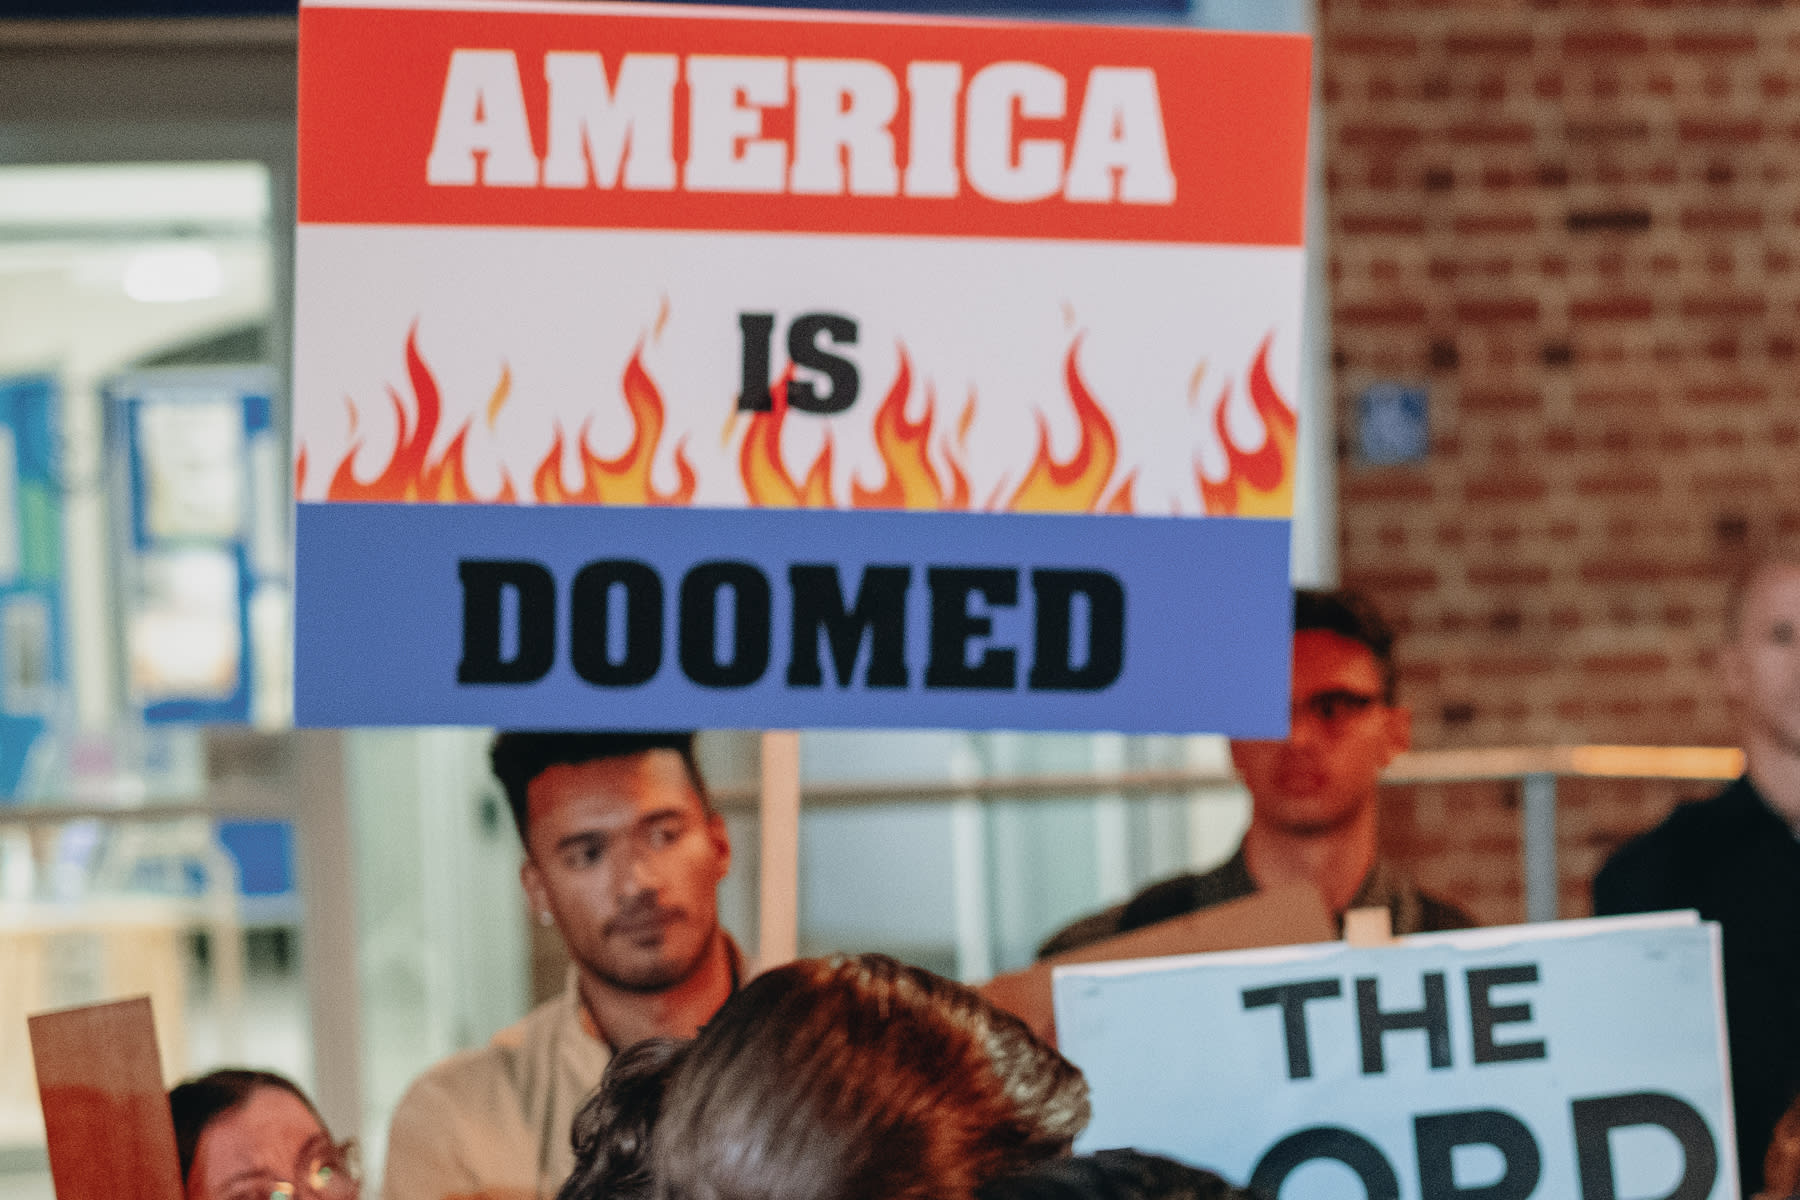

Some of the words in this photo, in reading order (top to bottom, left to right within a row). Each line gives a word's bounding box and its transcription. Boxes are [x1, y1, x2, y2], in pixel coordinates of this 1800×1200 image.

[427, 48, 1177, 206] AMERICA
[736, 311, 862, 415] IS
[456, 559, 1126, 692] DOOMED
[1241, 964, 1546, 1080] THE
